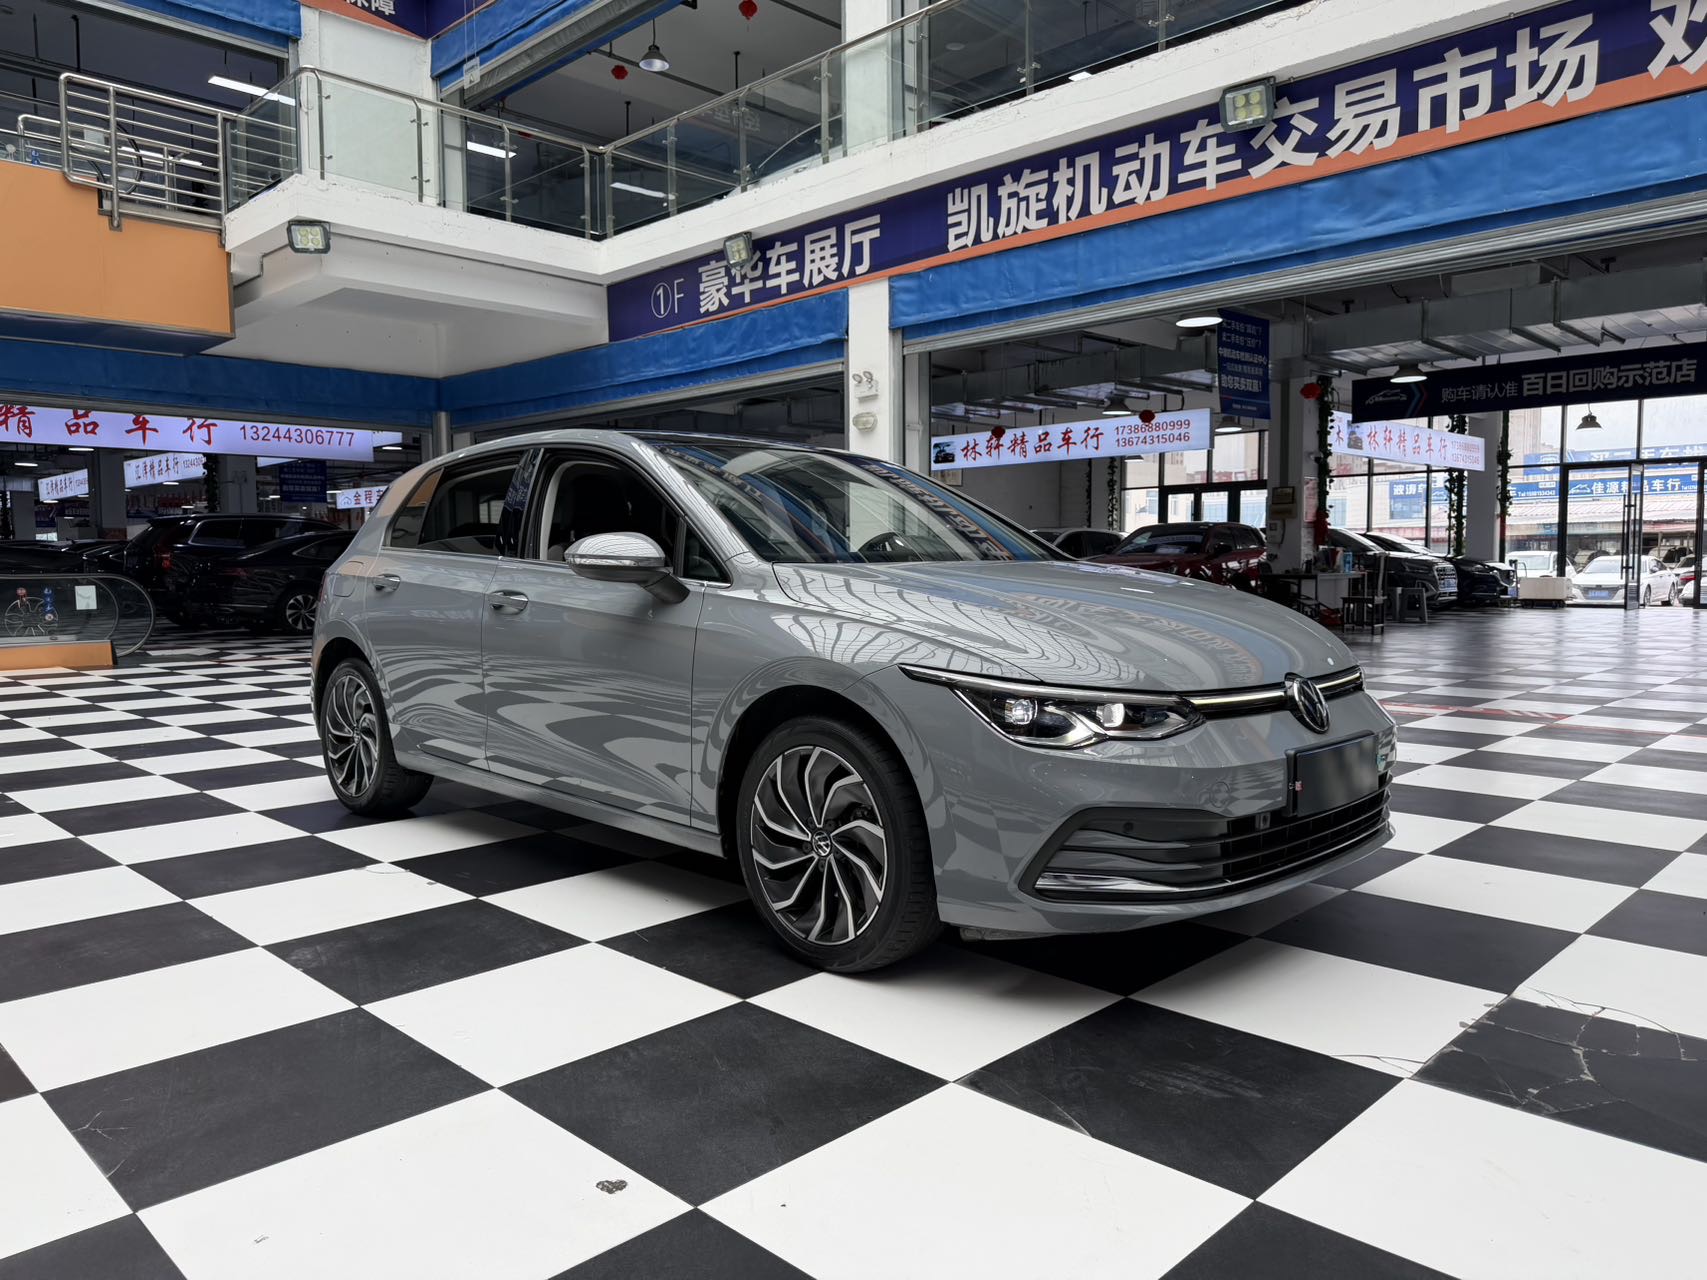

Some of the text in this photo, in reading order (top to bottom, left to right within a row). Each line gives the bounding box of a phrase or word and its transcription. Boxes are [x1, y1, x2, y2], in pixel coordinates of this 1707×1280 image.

[698, 214, 881, 314] 豪华车展厅
[947, 12, 1600, 253] 凯旋机动车交易市场
[1441, 358, 1697, 403] 购车请认准 百日回购示范店
[0, 405, 218, 446] 精品车行
[240, 424, 355, 447] 13244306777
[1114, 419, 1191, 436] 17386880999
[1115, 431, 1190, 448] 13674315046
[960, 426, 1104, 463] 林轩精品车行
